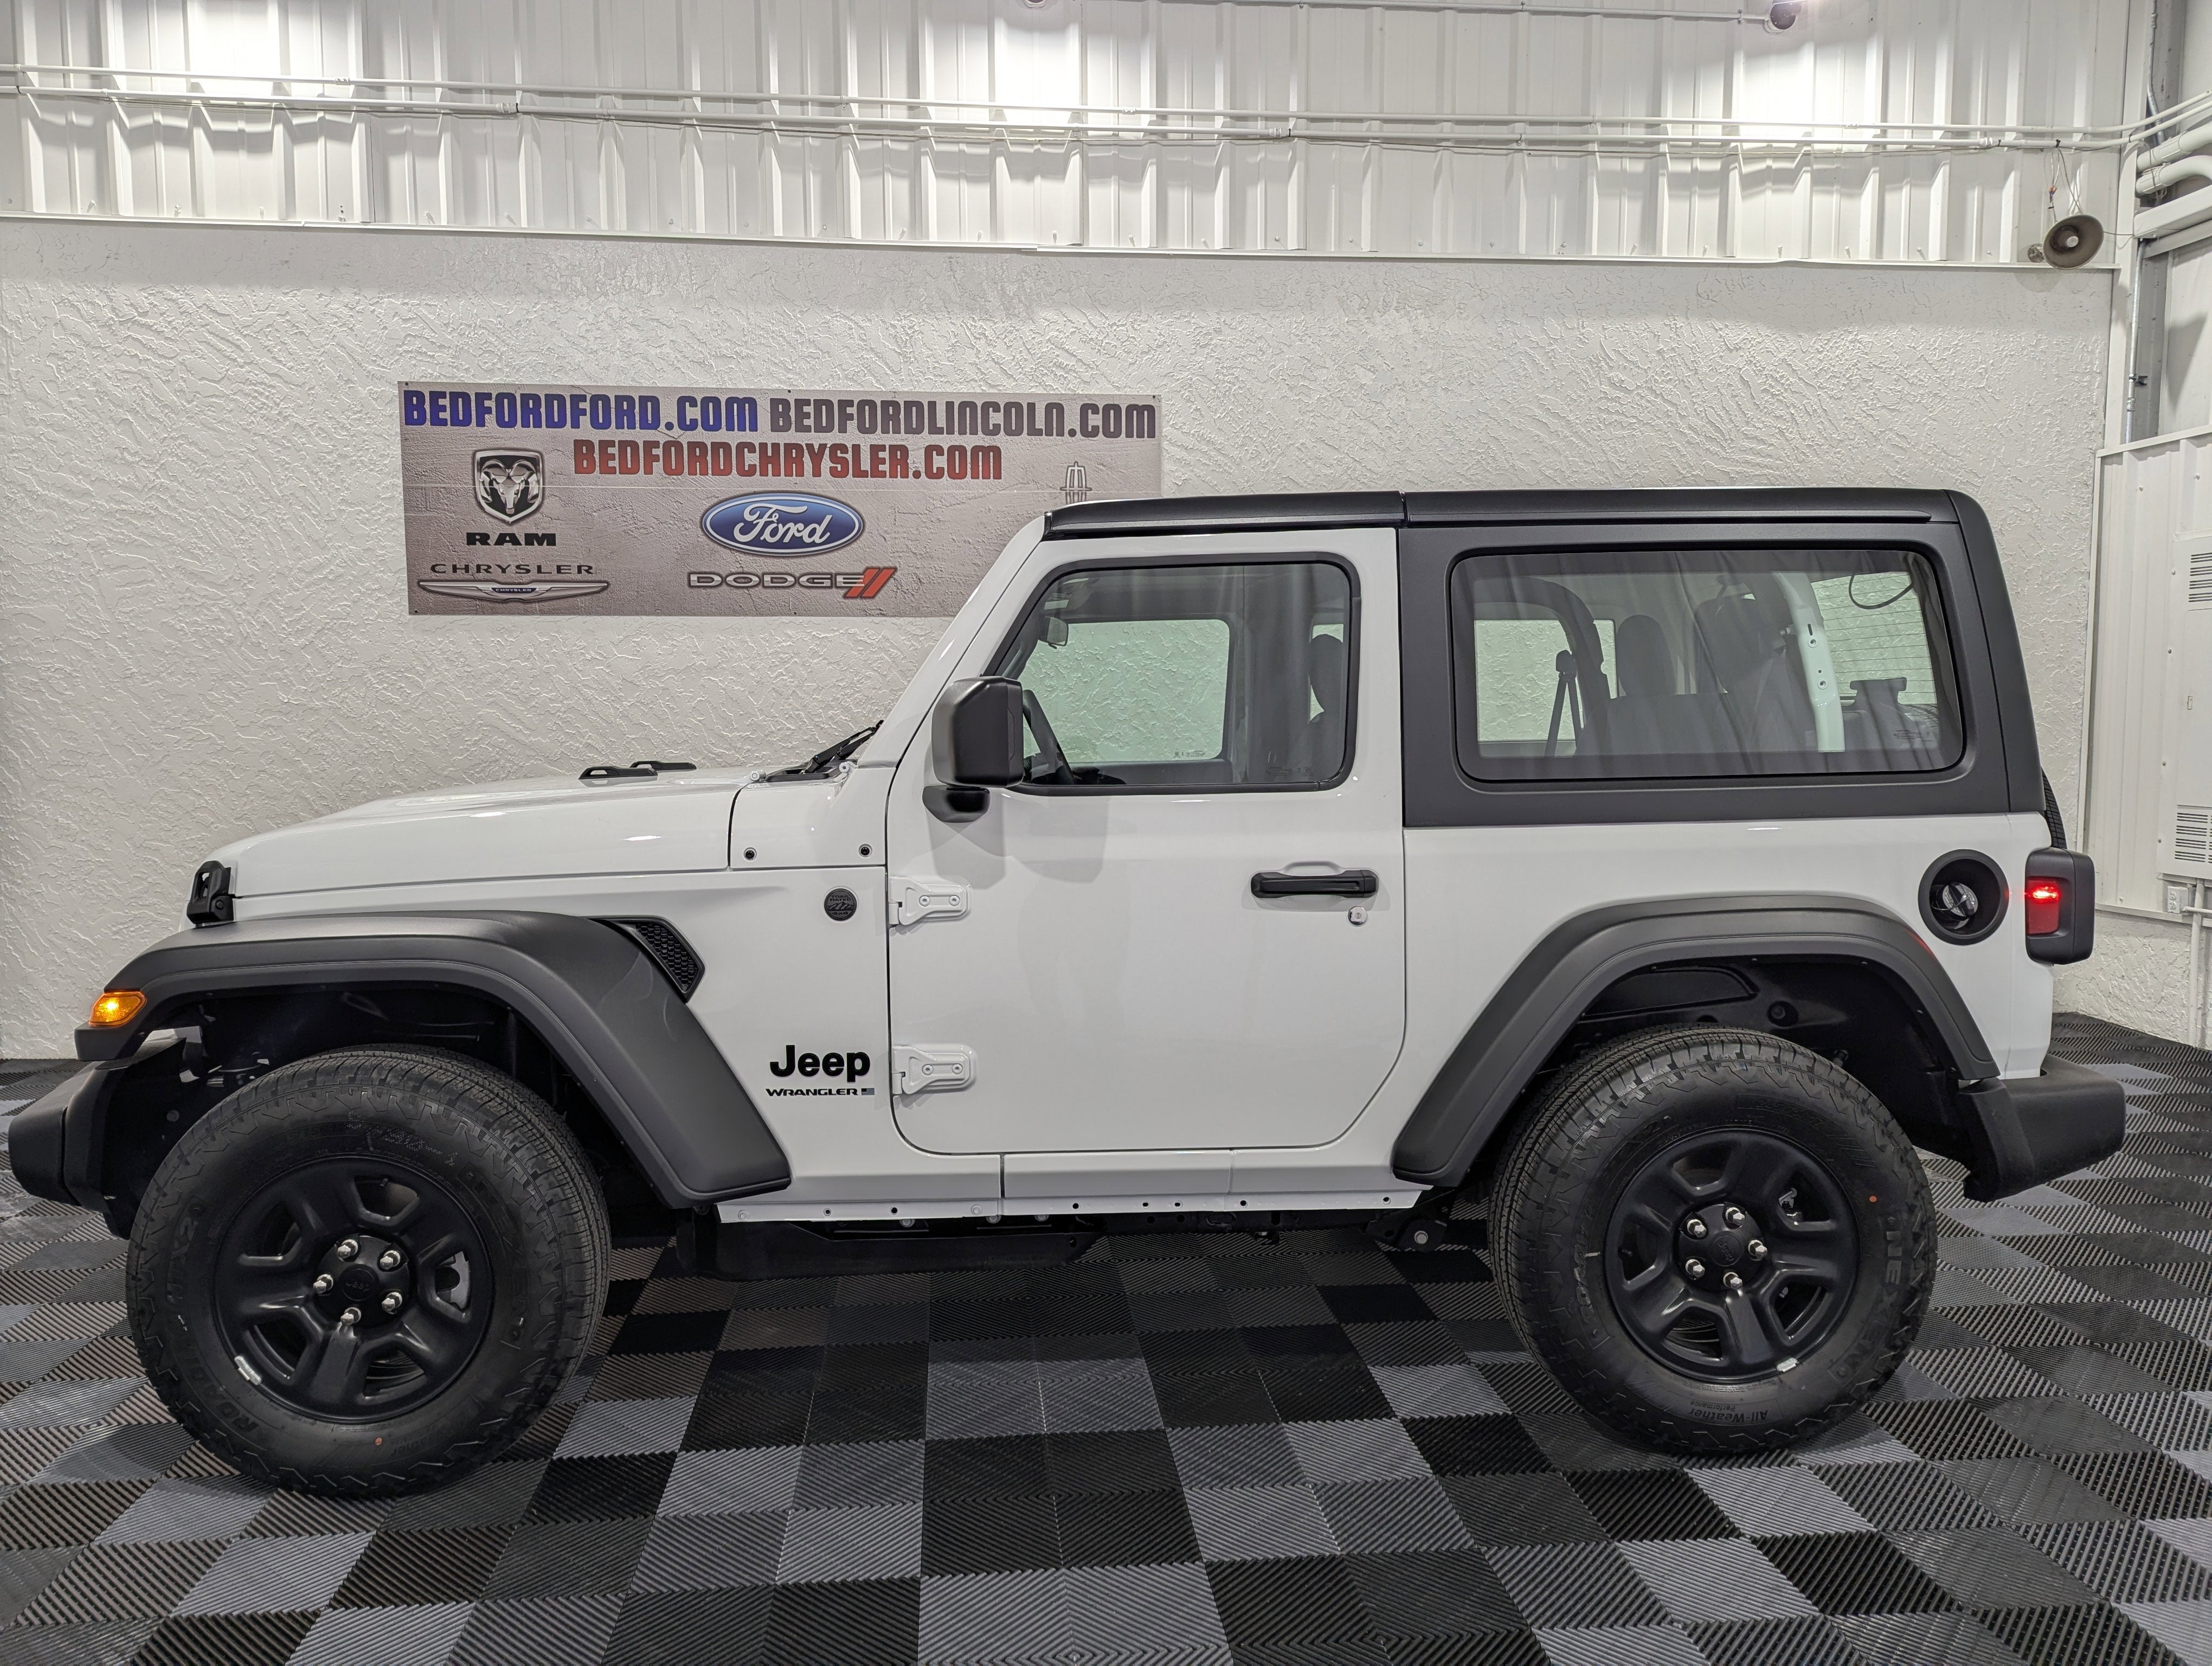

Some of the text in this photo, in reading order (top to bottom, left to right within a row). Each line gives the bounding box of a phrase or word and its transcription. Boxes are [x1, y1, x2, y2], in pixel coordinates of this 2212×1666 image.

[404, 390, 1156, 439] BEDFORDFORD.COM BEDFORDLINCOLN.COM
[574, 439, 1002, 480] BEDFORDCHRYSLER.COM
[734, 505, 833, 543] Ford
[466, 533, 557, 547] RAM
[430, 563, 594, 575] CHRYSLER
[690, 572, 866, 589] DODGE
[770, 1045, 870, 1082] Jeep
[1690, 1401, 1735, 1412] Performance
[1687, 1408, 1768, 1423] All-Weather
